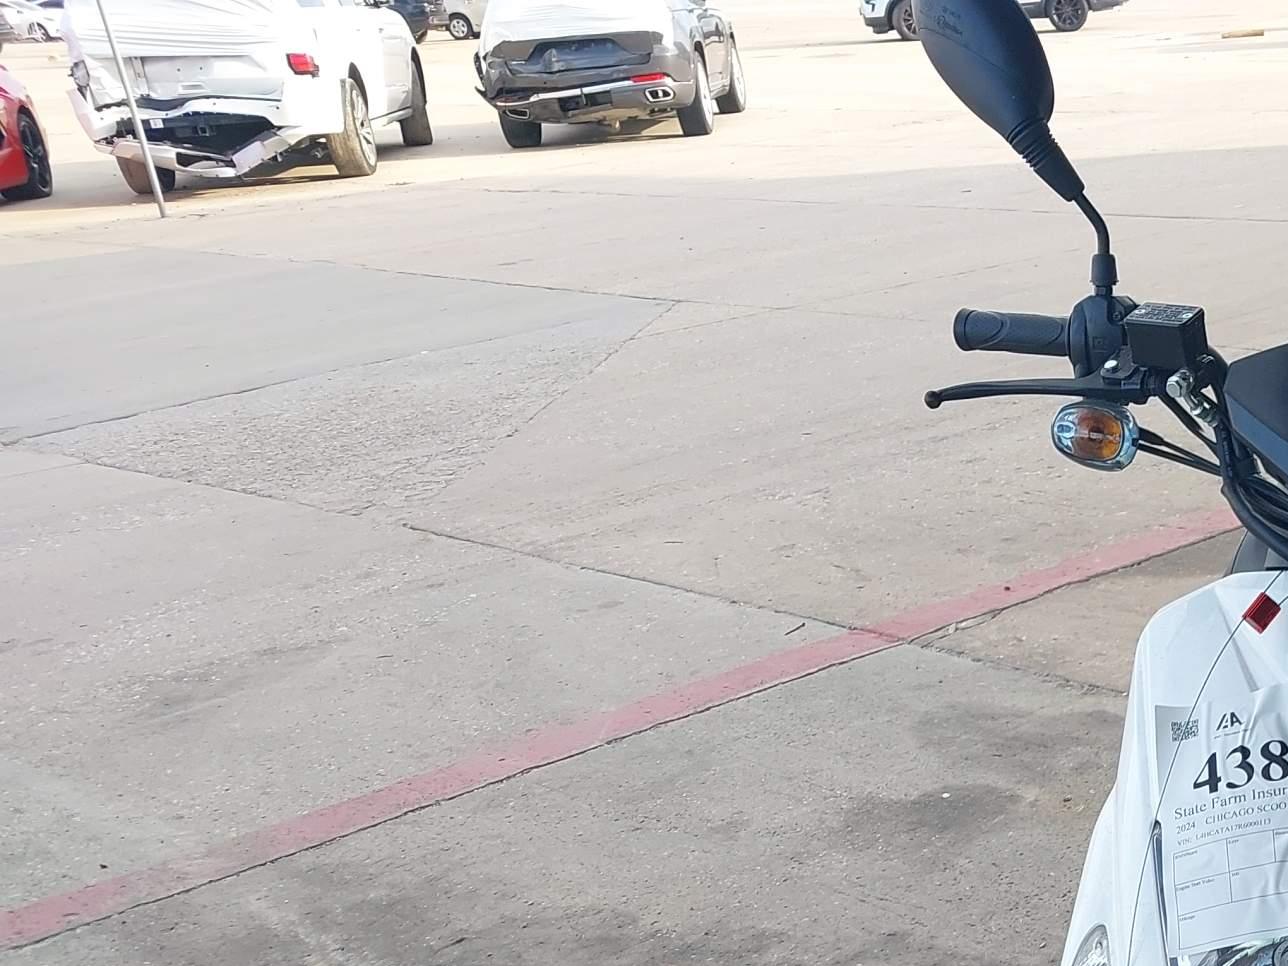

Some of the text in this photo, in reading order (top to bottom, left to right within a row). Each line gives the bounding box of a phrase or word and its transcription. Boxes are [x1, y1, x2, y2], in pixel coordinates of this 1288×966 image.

[1174, 802, 1207, 820] State
[1211, 794, 1247, 809] Farm
[1176, 821, 1196, 834] 2024
[1205, 807, 1255, 825] CHICAGO
[1257, 801, 1287, 814] SCOO
